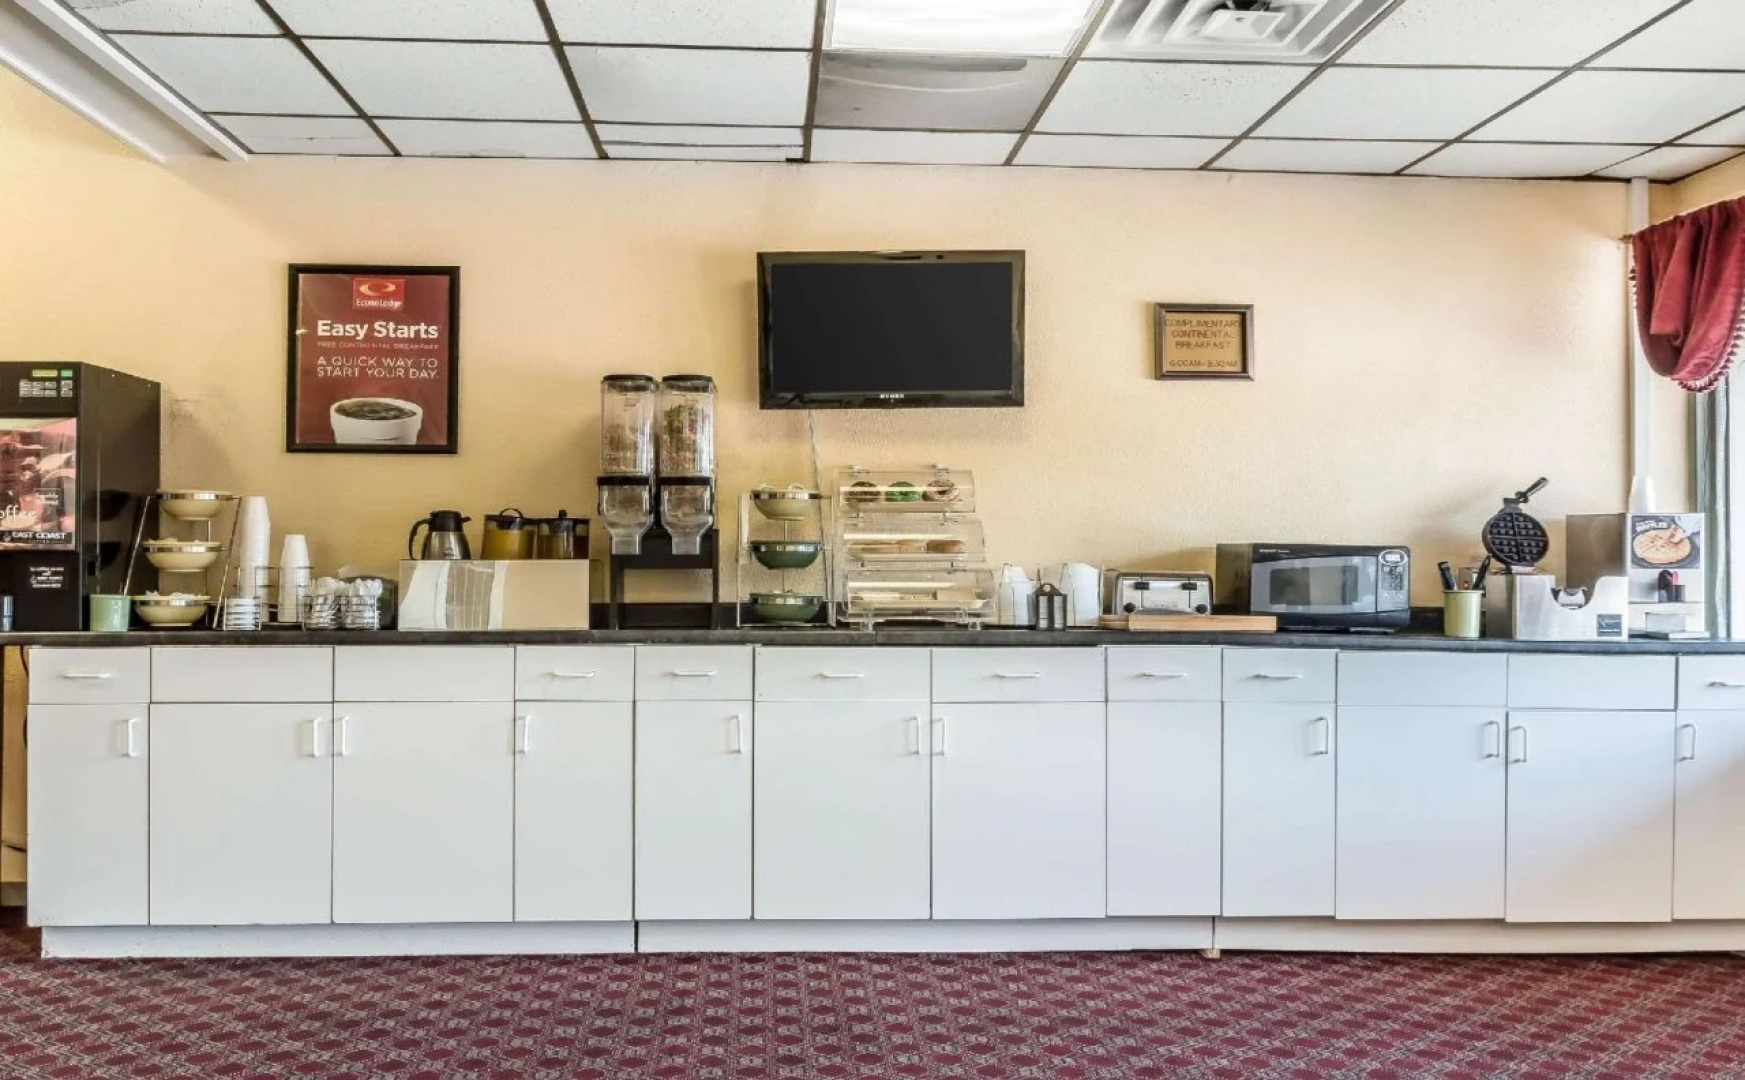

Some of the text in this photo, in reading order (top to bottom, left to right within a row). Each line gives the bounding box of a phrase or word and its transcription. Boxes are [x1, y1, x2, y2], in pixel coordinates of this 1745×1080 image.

[317, 320, 438, 340] Easy Starts
[1171, 329, 1237, 338] CONTINENTAL
[1175, 341, 1231, 349] BREAKFAST
[317, 355, 438, 368] A QUICK WAY TO
[317, 366, 359, 378] START
[366, 367, 405, 378] YOUR
[12, 531, 66, 540] EAST COAST
